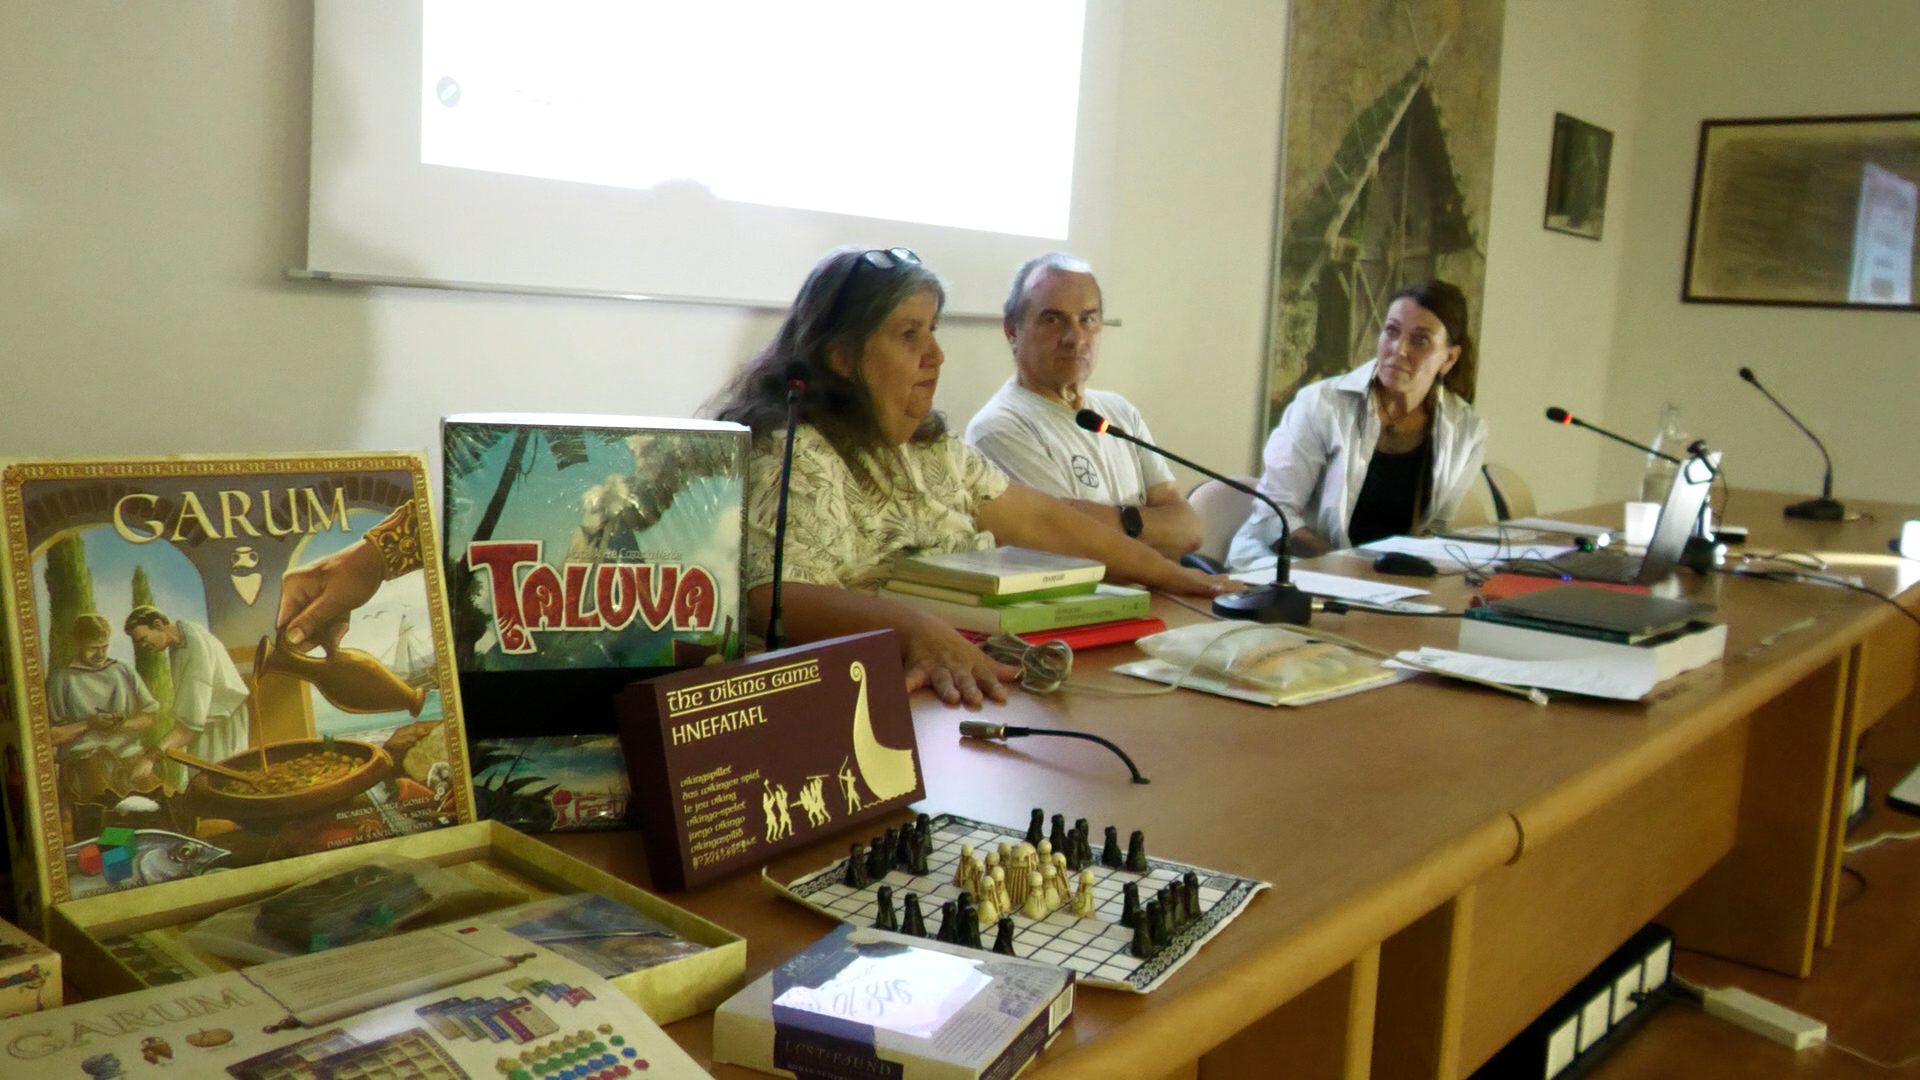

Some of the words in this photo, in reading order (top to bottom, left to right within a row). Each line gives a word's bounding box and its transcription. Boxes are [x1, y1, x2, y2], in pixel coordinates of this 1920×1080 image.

[113, 487, 352, 544] GARUM
[467, 540, 718, 655] TALUVA
[667, 689, 704, 712] the
[709, 679, 767, 702] viking
[771, 664, 819, 687] game
[671, 705, 768, 746] HNEFATAFL
[680, 765, 732, 788] vikingspillet
[682, 790, 699, 801] das
[740, 769, 761, 784] spiel
[335, 807, 373, 820] RICARDO
[403, 796, 430, 808] GOMES
[410, 808, 432, 819] SOTO
[683, 803, 693, 814] le
[695, 800, 709, 813] jeu
[711, 791, 737, 806] viking
[327, 837, 353, 848] DAVID
[688, 826, 713, 843] juego
[715, 816, 746, 832] vikingo
[7, 987, 254, 1060] GARUM
